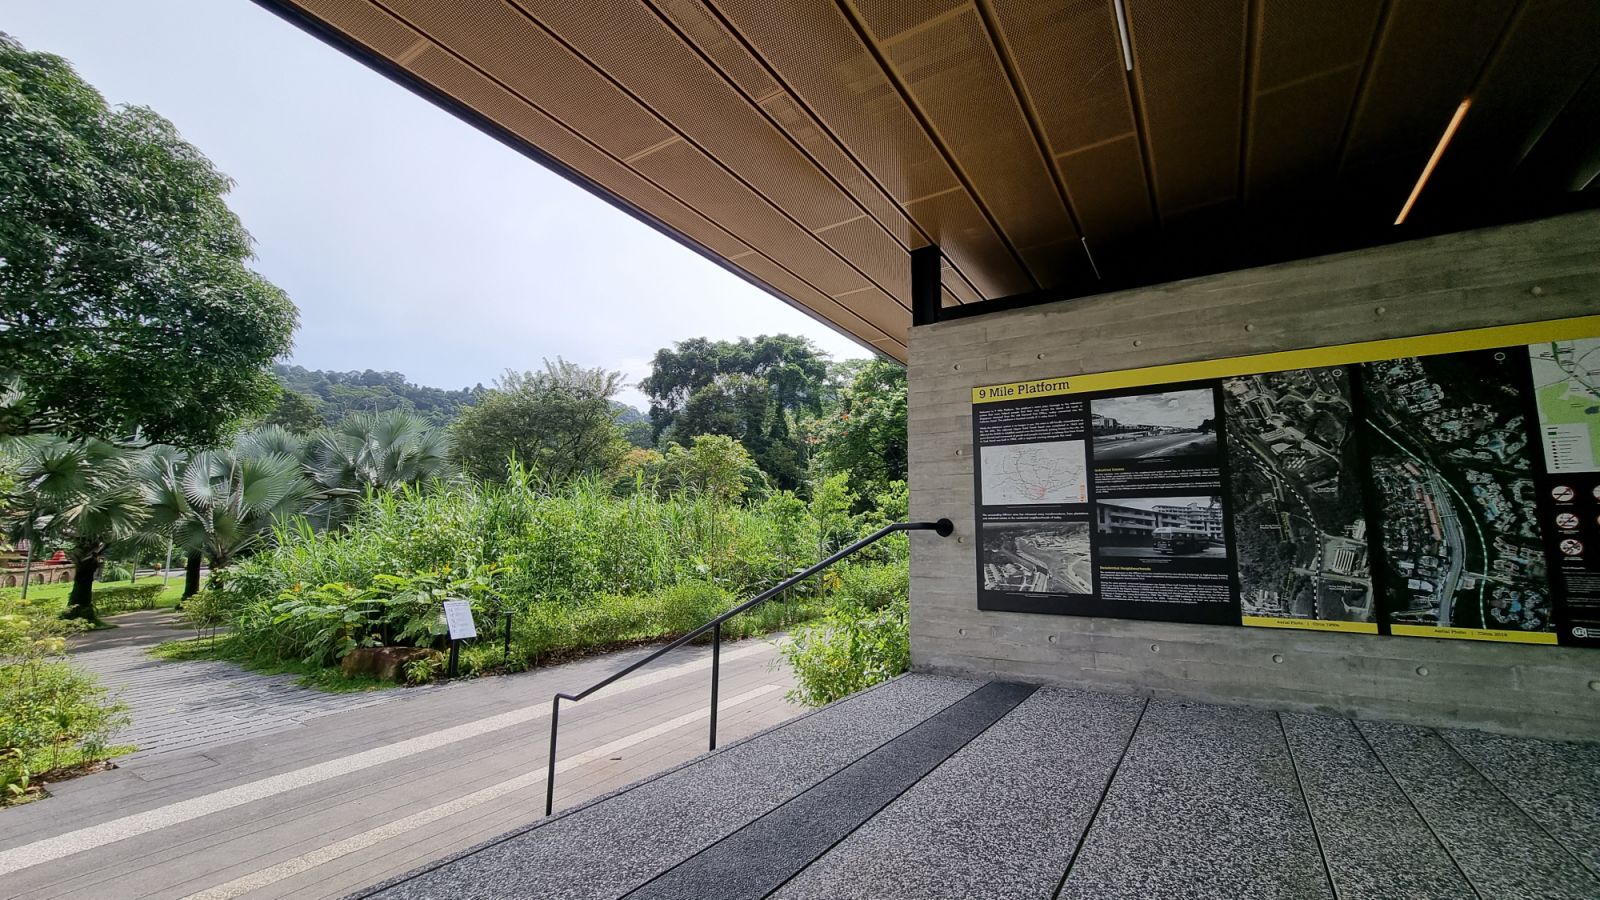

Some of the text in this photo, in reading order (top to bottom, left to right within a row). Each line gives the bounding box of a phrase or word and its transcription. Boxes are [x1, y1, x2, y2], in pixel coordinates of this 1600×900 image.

[979, 381, 1070, 399] 9 Mile Platform
